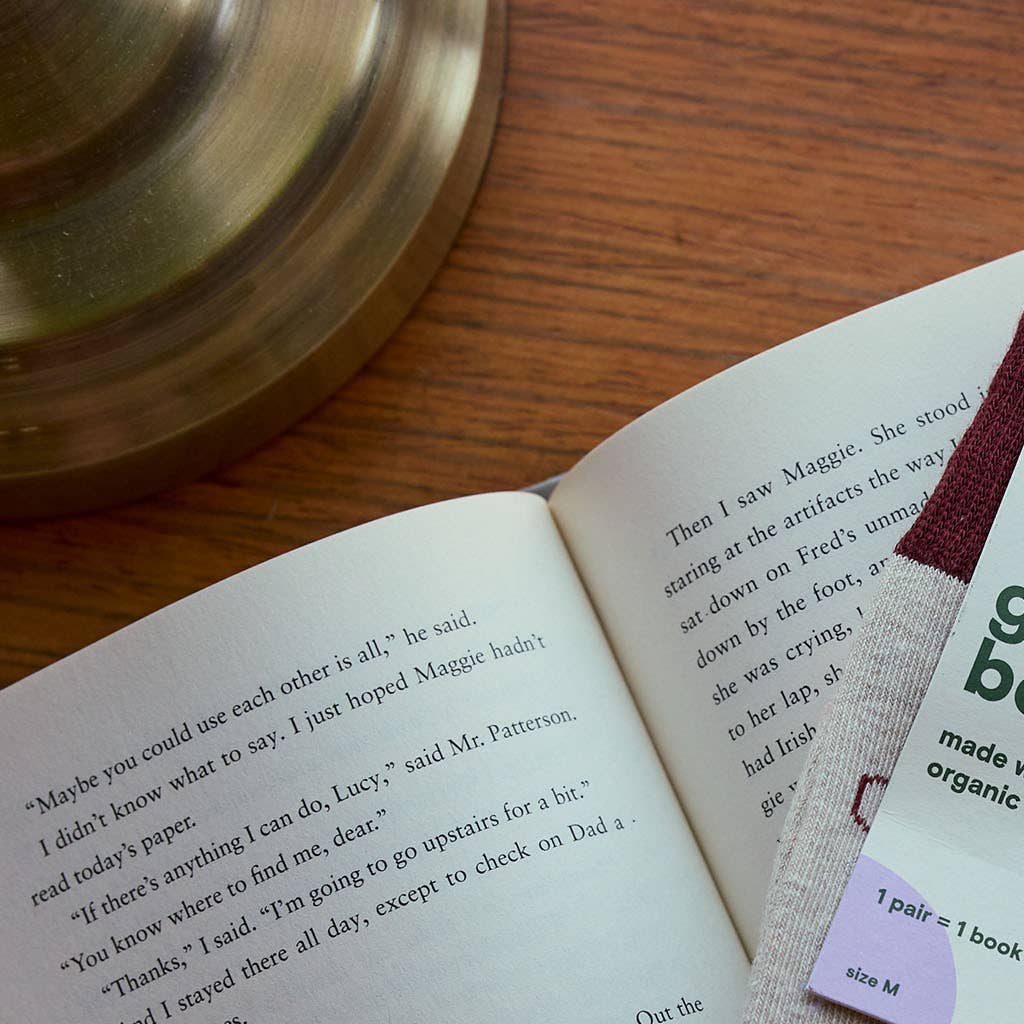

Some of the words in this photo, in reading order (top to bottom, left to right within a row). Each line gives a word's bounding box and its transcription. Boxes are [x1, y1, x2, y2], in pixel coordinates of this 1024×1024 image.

[666, 515, 713, 547] Then
[718, 500, 730, 517] I
[738, 481, 771, 508] saw
[782, 444, 862, 486] Maggie.
[871, 424, 907, 445] She
[916, 392, 971, 427] stood
[665, 556, 721, 598] staring
[725, 542, 743, 560] at
[747, 525, 777, 547] the
[784, 484, 863, 529] artifacts
[868, 469, 900, 489] the
[905, 449, 943, 472] way
[681, 611, 703, 633] sat
[710, 580, 759, 614] down
[767, 562, 791, 581] on
[697, 635, 742, 668] down
[744, 617, 768, 637] by
[776, 599, 807, 621] the
[813, 574, 862, 603] foot,
[102, 756, 138, 785] you
[142, 722, 193, 761] could
[196, 712, 228, 733] use
[232, 686, 276, 717] each
[281, 665, 330, 694] other
[334, 655, 352, 672] is
[403, 628, 428, 645] he
[433, 610, 476, 636] said.
[713, 682, 738, 705] she
[744, 658, 778, 683] was
[786, 623, 852, 660] crying,
[728, 724, 745, 741] to
[747, 703, 777, 728] her
[780, 685, 819, 708] lap,
[742, 745, 775, 777] had
[775, 723, 816, 757] Irish
[939, 730, 1008, 768] made
[762, 792, 784, 818] gie
[927, 762, 1021, 810] organic
[160, 1000, 172, 1019] I
[178, 968, 236, 1011] stayed
[241, 949, 289, 979] there
[296, 928, 321, 953] all
[328, 914, 369, 938] day,
[376, 880, 439, 916] except
[445, 870, 466, 886] to
[476, 842, 531, 874] check
[539, 835, 563, 851] on
[568, 816, 608, 841] Dad
[878, 889, 887, 904] 1
[888, 898, 932, 922] pair
[958, 921, 966, 937] 1
[969, 926, 1023, 961] book
[677, 997, 704, 1016] the
[846, 967, 878, 987] size
[882, 979, 900, 996] M
